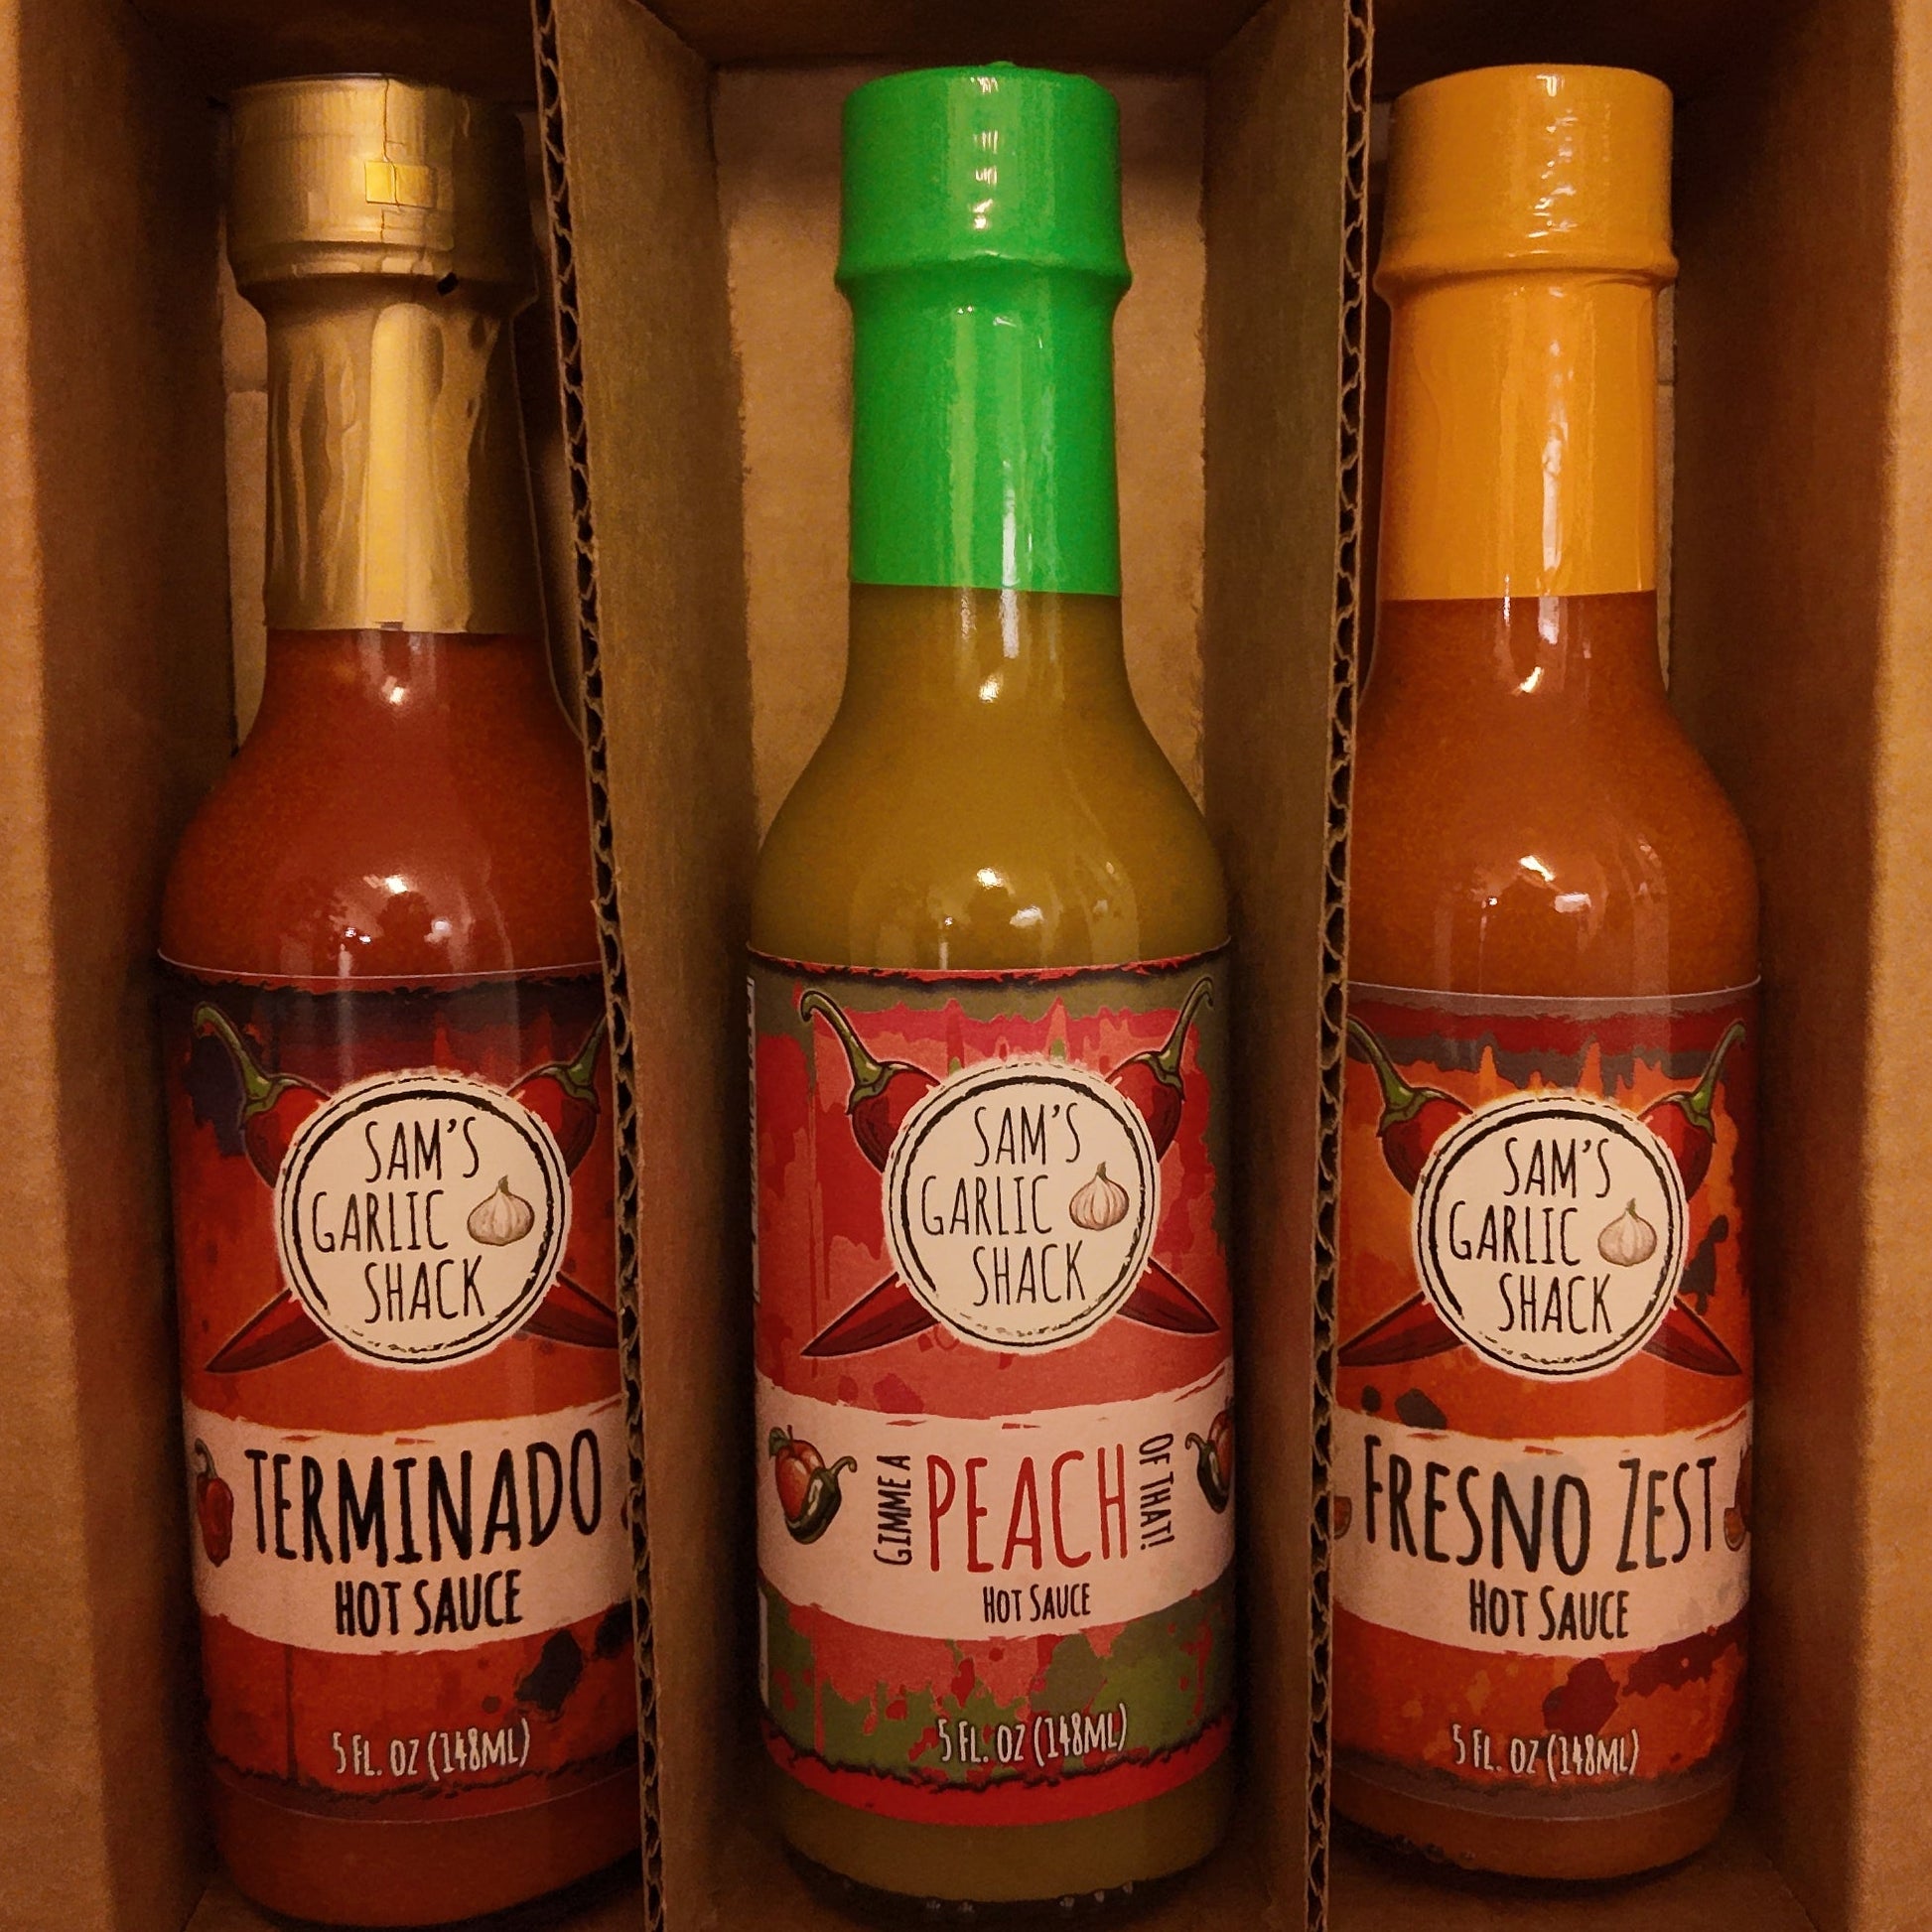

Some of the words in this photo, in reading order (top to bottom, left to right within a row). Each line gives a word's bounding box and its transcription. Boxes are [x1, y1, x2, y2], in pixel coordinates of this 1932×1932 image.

[363, 1116, 481, 1183] SAM'S
[973, 1102, 1081, 1167] SAM'S
[1502, 1137, 1612, 1199] SAM'S
[312, 1188, 449, 1253] GARLIC
[921, 1174, 1053, 1237] GARLIC
[1449, 1200, 1582, 1266] GARLIC
[363, 1255, 485, 1323] SHACK
[972, 1240, 1086, 1307] SHACK
[1497, 1272, 1612, 1335] SHACK
[876, 1454, 911, 1471] A
[1139, 1433, 1173, 1465] OF
[244, 1428, 602, 1568] TERMINADO
[874, 1475, 912, 1566] GIMME
[925, 1444, 1128, 1573] PEACH
[1139, 1470, 1174, 1550] THAT!
[1363, 1434, 1590, 1576] FRESNO
[1615, 1455, 1717, 1574] ZEST
[335, 1579, 401, 1637] HOT
[414, 1568, 522, 1636] SAUCE
[982, 1586, 1023, 1624] HOT
[1030, 1583, 1092, 1622] SAUCE
[1469, 1578, 1529, 1638] HOT
[1538, 1585, 1629, 1641] SAUCE
[333, 1731, 346, 1774] 5
[351, 1735, 383, 1777] FL.
[389, 1737, 419, 1776] OZ
[427, 1717, 531, 1781] (148ML)
[936, 1719, 952, 1762] 5
[958, 1726, 989, 1763] FL.
[997, 1724, 1025, 1763] OZ
[1034, 1703, 1128, 1767] (148ML)
[1451, 1723, 1465, 1765] 5
[1472, 1728, 1502, 1773] FL.
[1510, 1737, 1539, 1775] OZ
[1547, 1728, 1640, 1782] (148ML)
